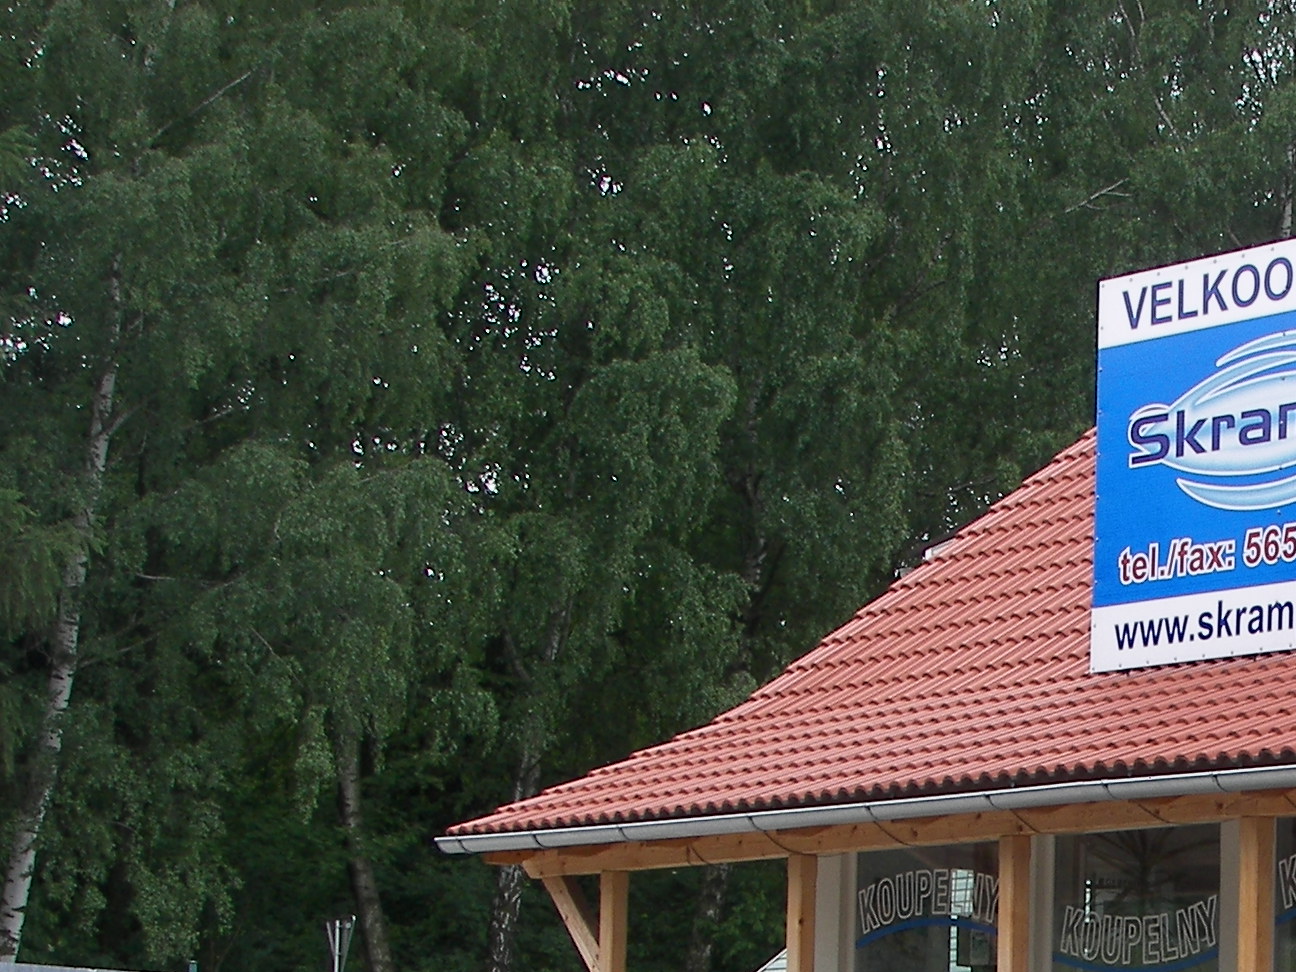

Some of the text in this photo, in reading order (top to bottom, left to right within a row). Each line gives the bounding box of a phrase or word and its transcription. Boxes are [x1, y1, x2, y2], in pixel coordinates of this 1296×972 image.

[1119, 537, 1236, 585] tel./fax:
[858, 867, 999, 934] KOUPELNY
[1060, 895, 1217, 965] KOUPELNY
